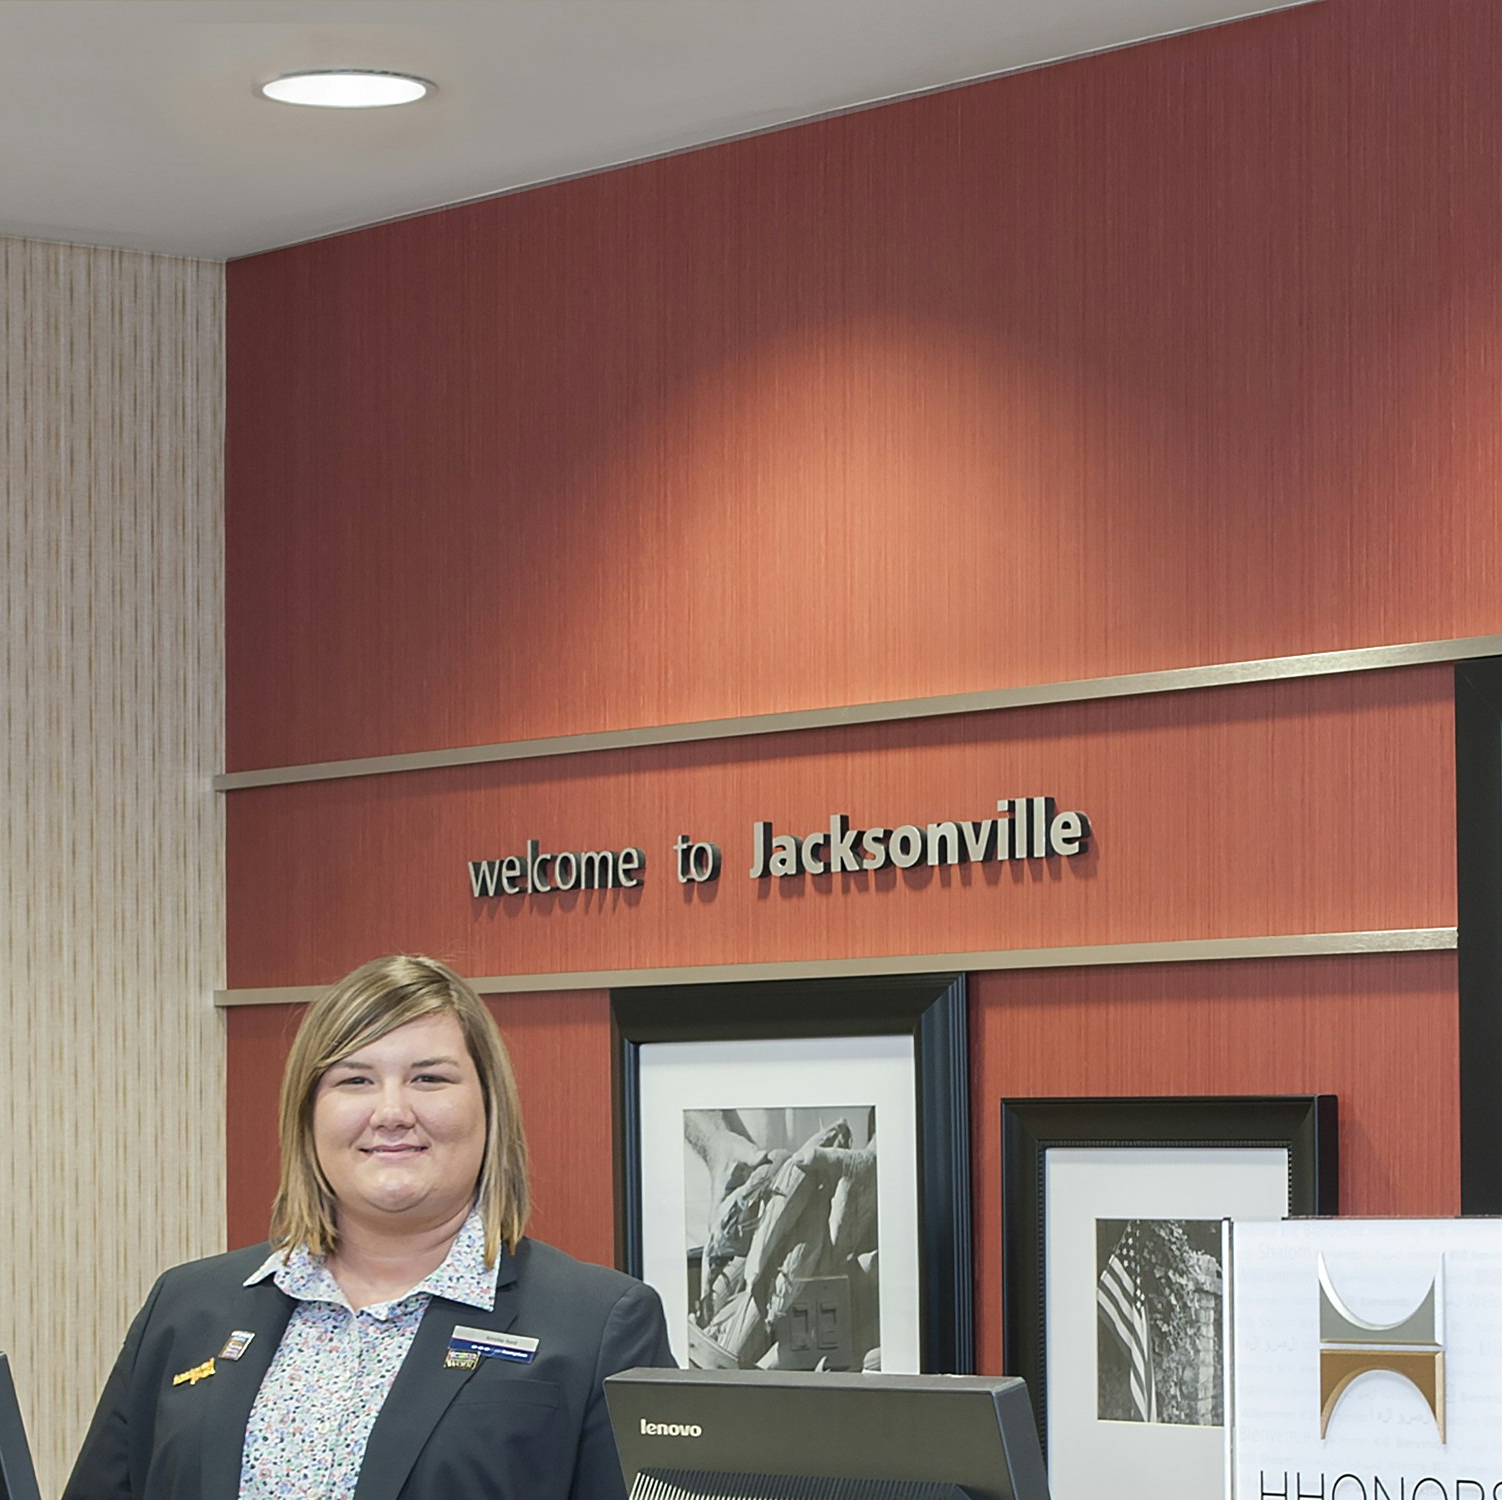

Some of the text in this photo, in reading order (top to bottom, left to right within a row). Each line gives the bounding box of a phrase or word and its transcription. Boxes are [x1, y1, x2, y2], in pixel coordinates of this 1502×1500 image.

[468, 796, 1090, 897] welcome to Jacksonville
[640, 1418, 702, 1437] lenovo
